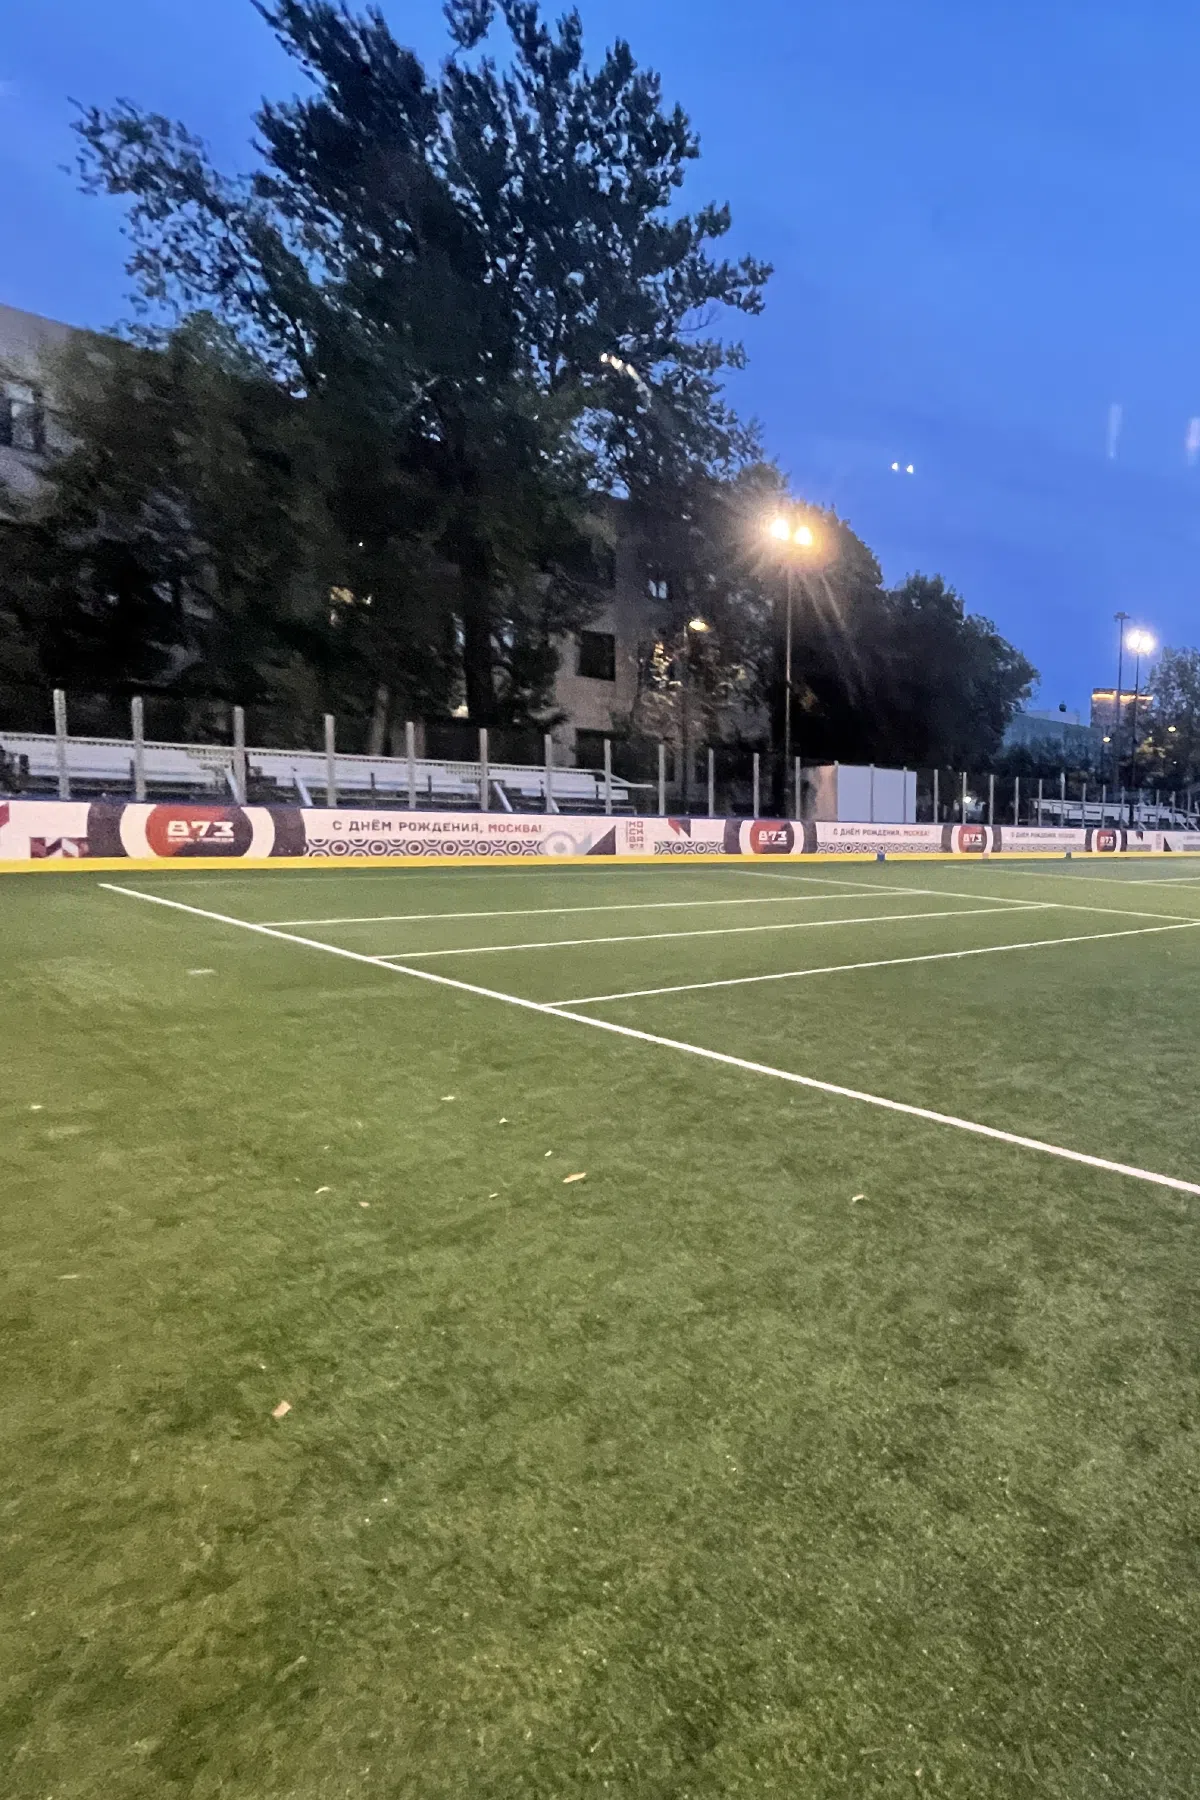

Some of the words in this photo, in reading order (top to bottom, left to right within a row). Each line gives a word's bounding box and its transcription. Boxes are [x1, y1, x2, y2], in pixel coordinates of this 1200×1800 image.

[168, 820, 234, 836] 873
[332, 820, 342, 830] С
[349, 819, 392, 832] ДНЁМ
[398, 822, 483, 833] РОЖДЕНИЯ,
[488, 823, 542, 833] МОСКВА!
[758, 830, 787, 841] 873
